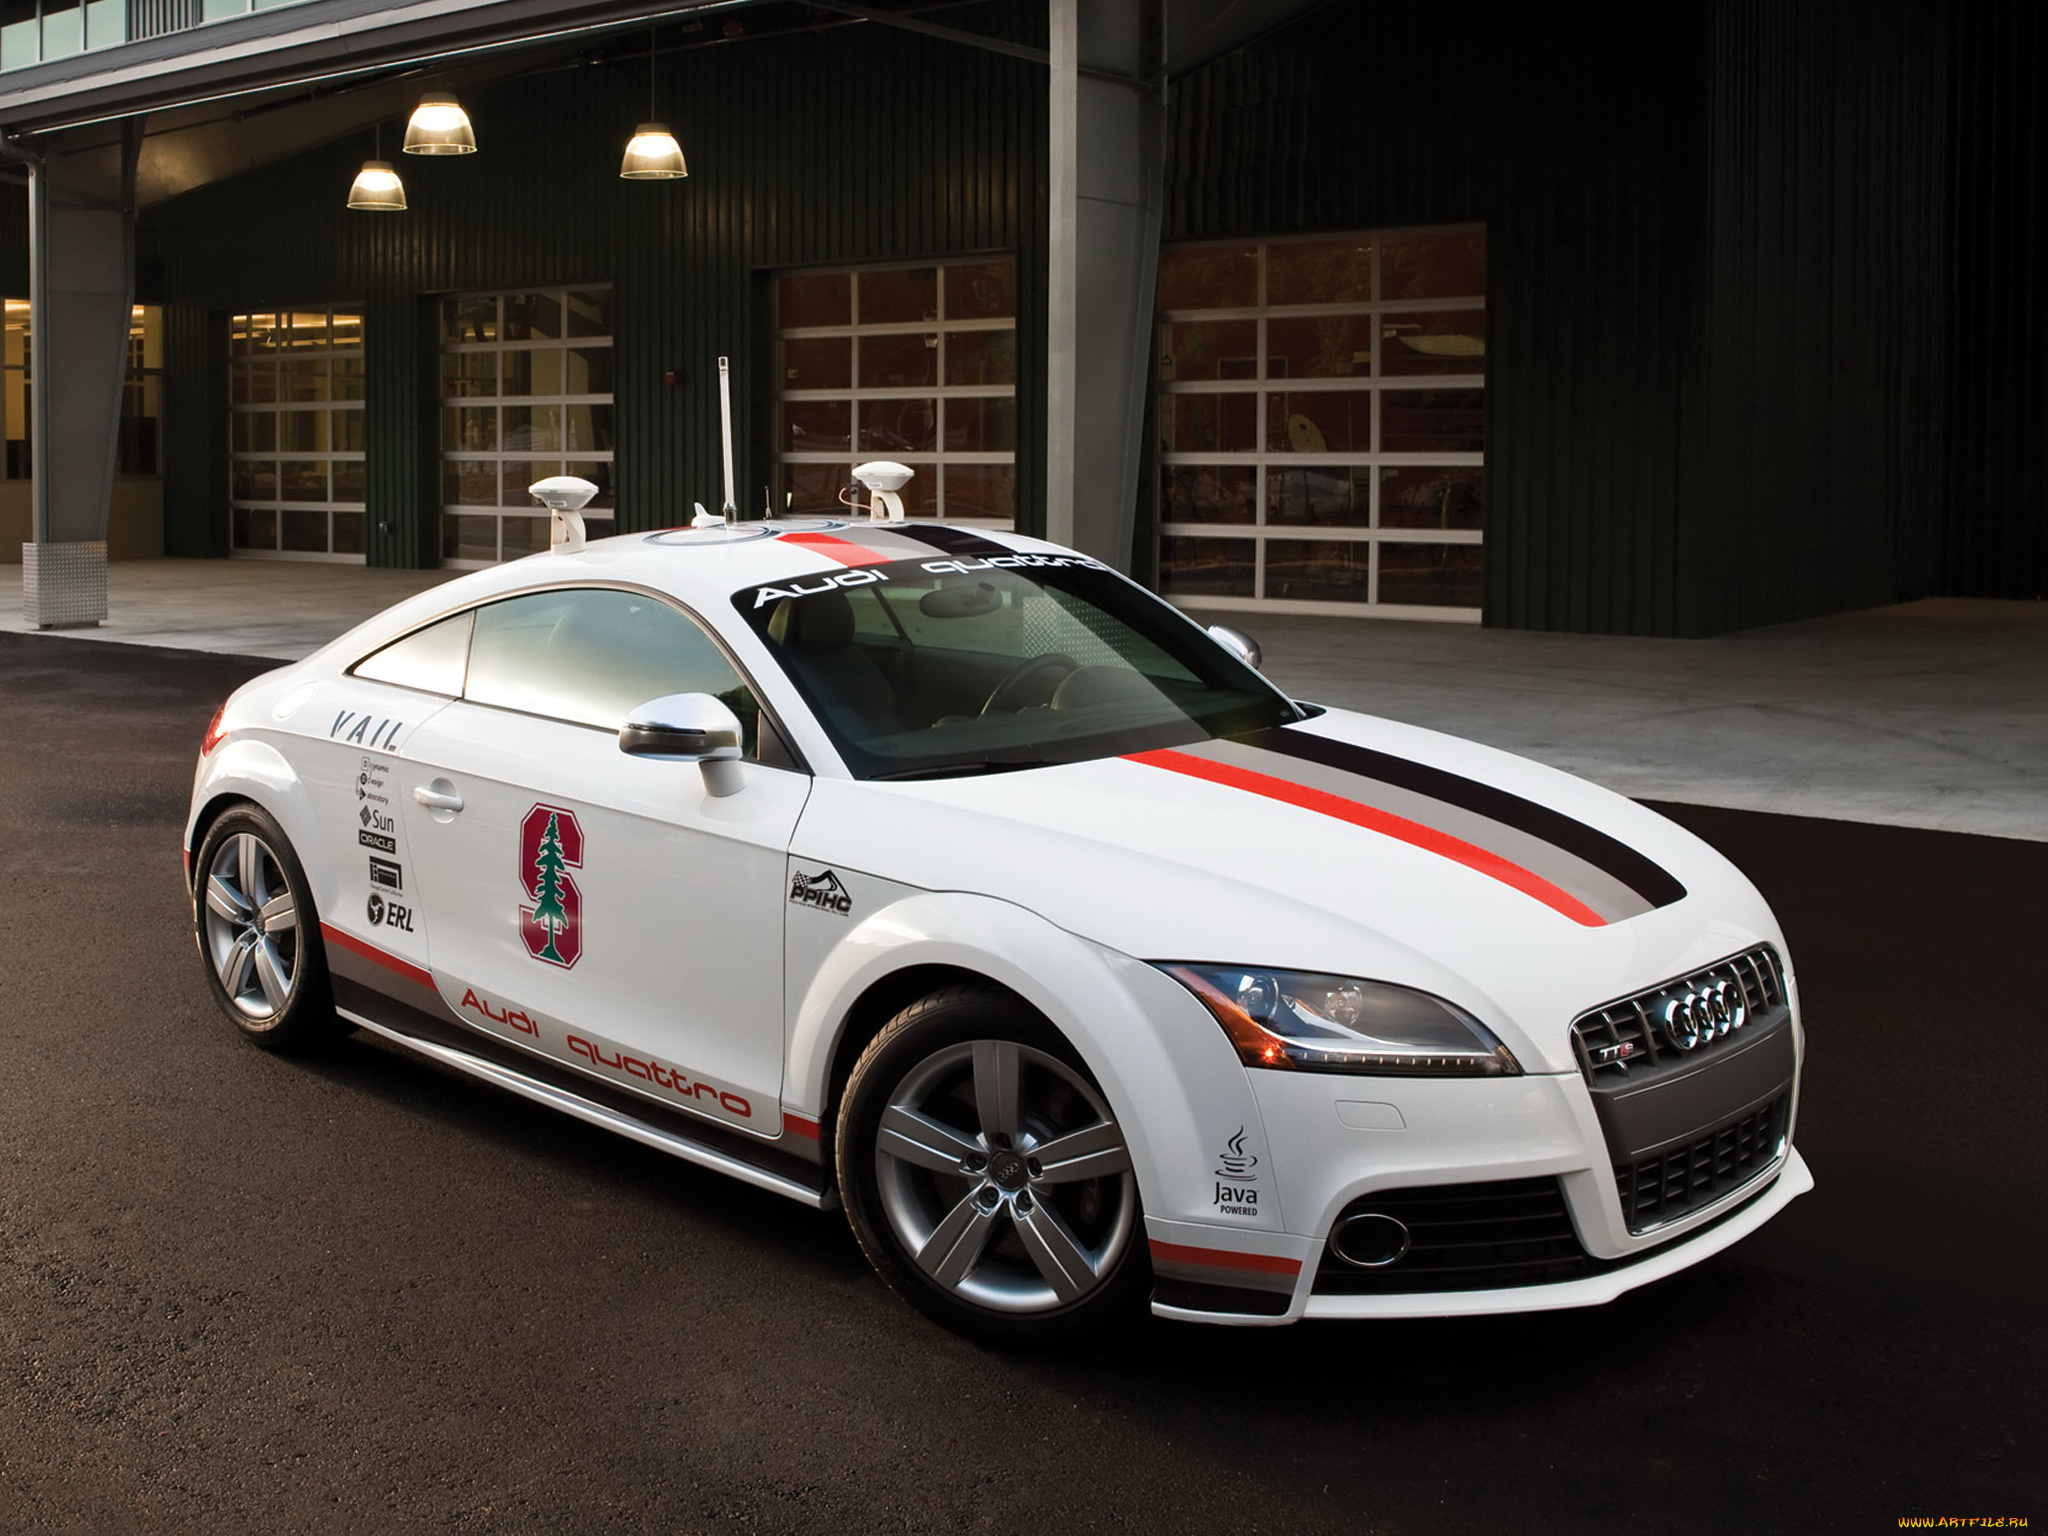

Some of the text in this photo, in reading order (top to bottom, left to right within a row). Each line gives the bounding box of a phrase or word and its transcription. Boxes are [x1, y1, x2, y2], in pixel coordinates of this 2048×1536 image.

[753, 554, 1106, 609] Audi quattro
[330, 710, 402, 752] VAIL
[372, 809, 394, 833] Sun
[360, 833, 394, 851] ORACLE
[789, 885, 853, 913] PPIHC
[386, 902, 414, 932] ERL
[461, 987, 752, 1119] Audi quattro
[1599, 1042, 1634, 1060] TTS
[1213, 1181, 1258, 1205] Java
[1220, 1204, 1258, 1216] POWERED
